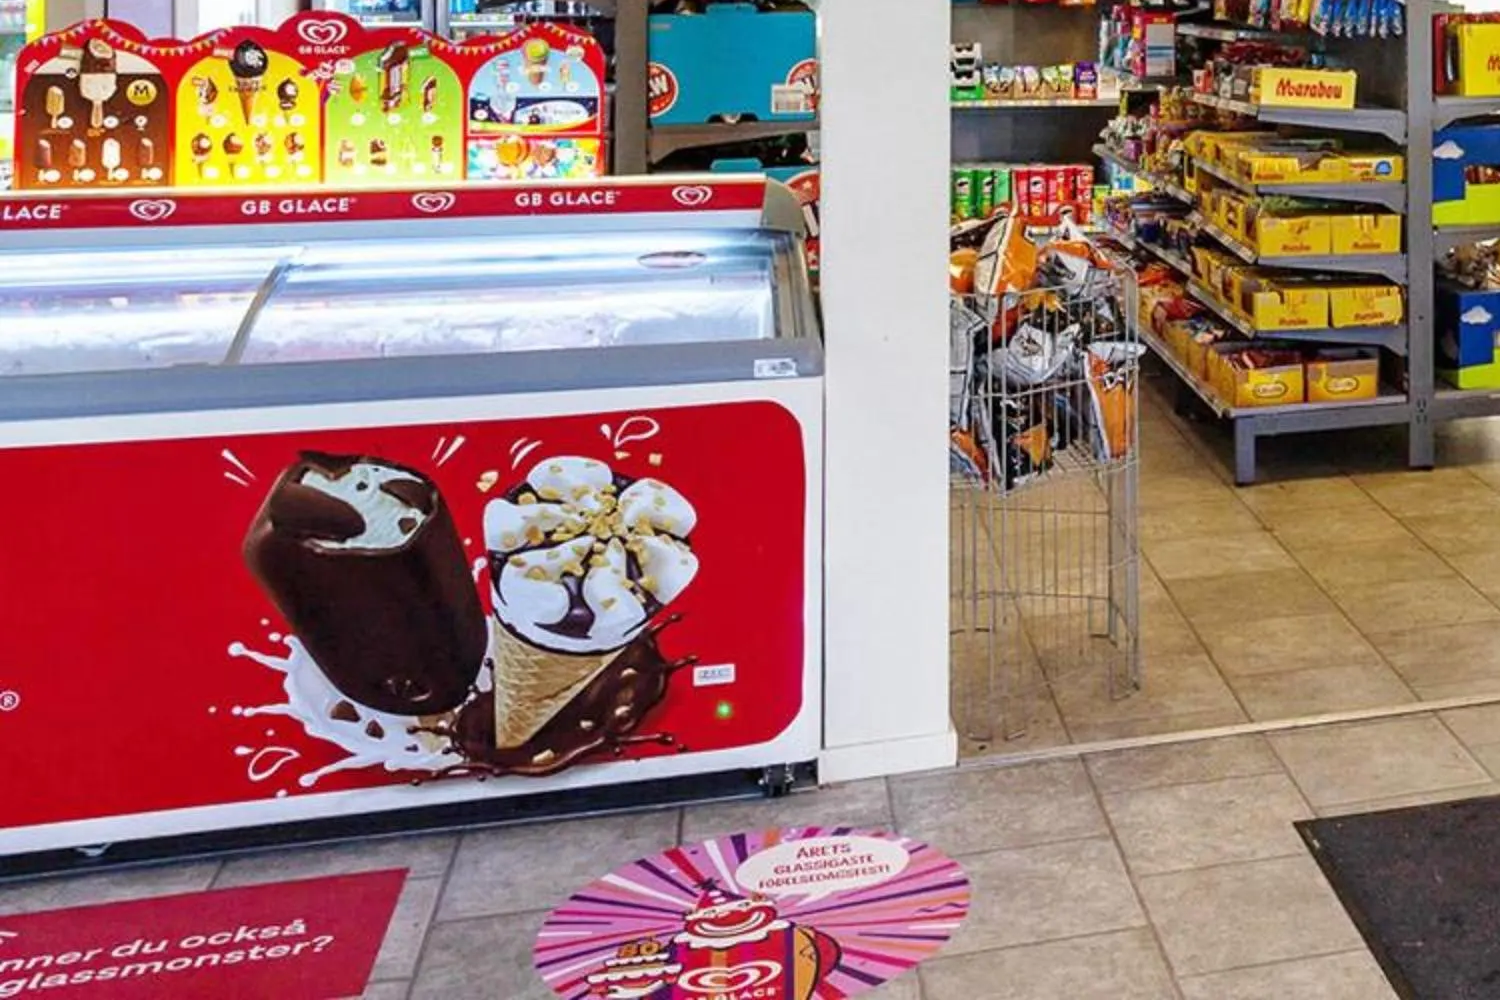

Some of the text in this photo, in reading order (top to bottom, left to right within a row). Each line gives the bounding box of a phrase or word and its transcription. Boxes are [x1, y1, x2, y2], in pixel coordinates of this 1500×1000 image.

[314, 45, 347, 54] GLACE
[1275, 77, 1343, 100] Marabou
[241, 197, 351, 215] GB GLACE
[514, 191, 616, 207] GB GLACE
[773, 854, 875, 875] GLASSIGASTE
[110, 935, 168, 958] du
[178, 917, 309, 949] också
[0, 934, 336, 998] glassmonster?
